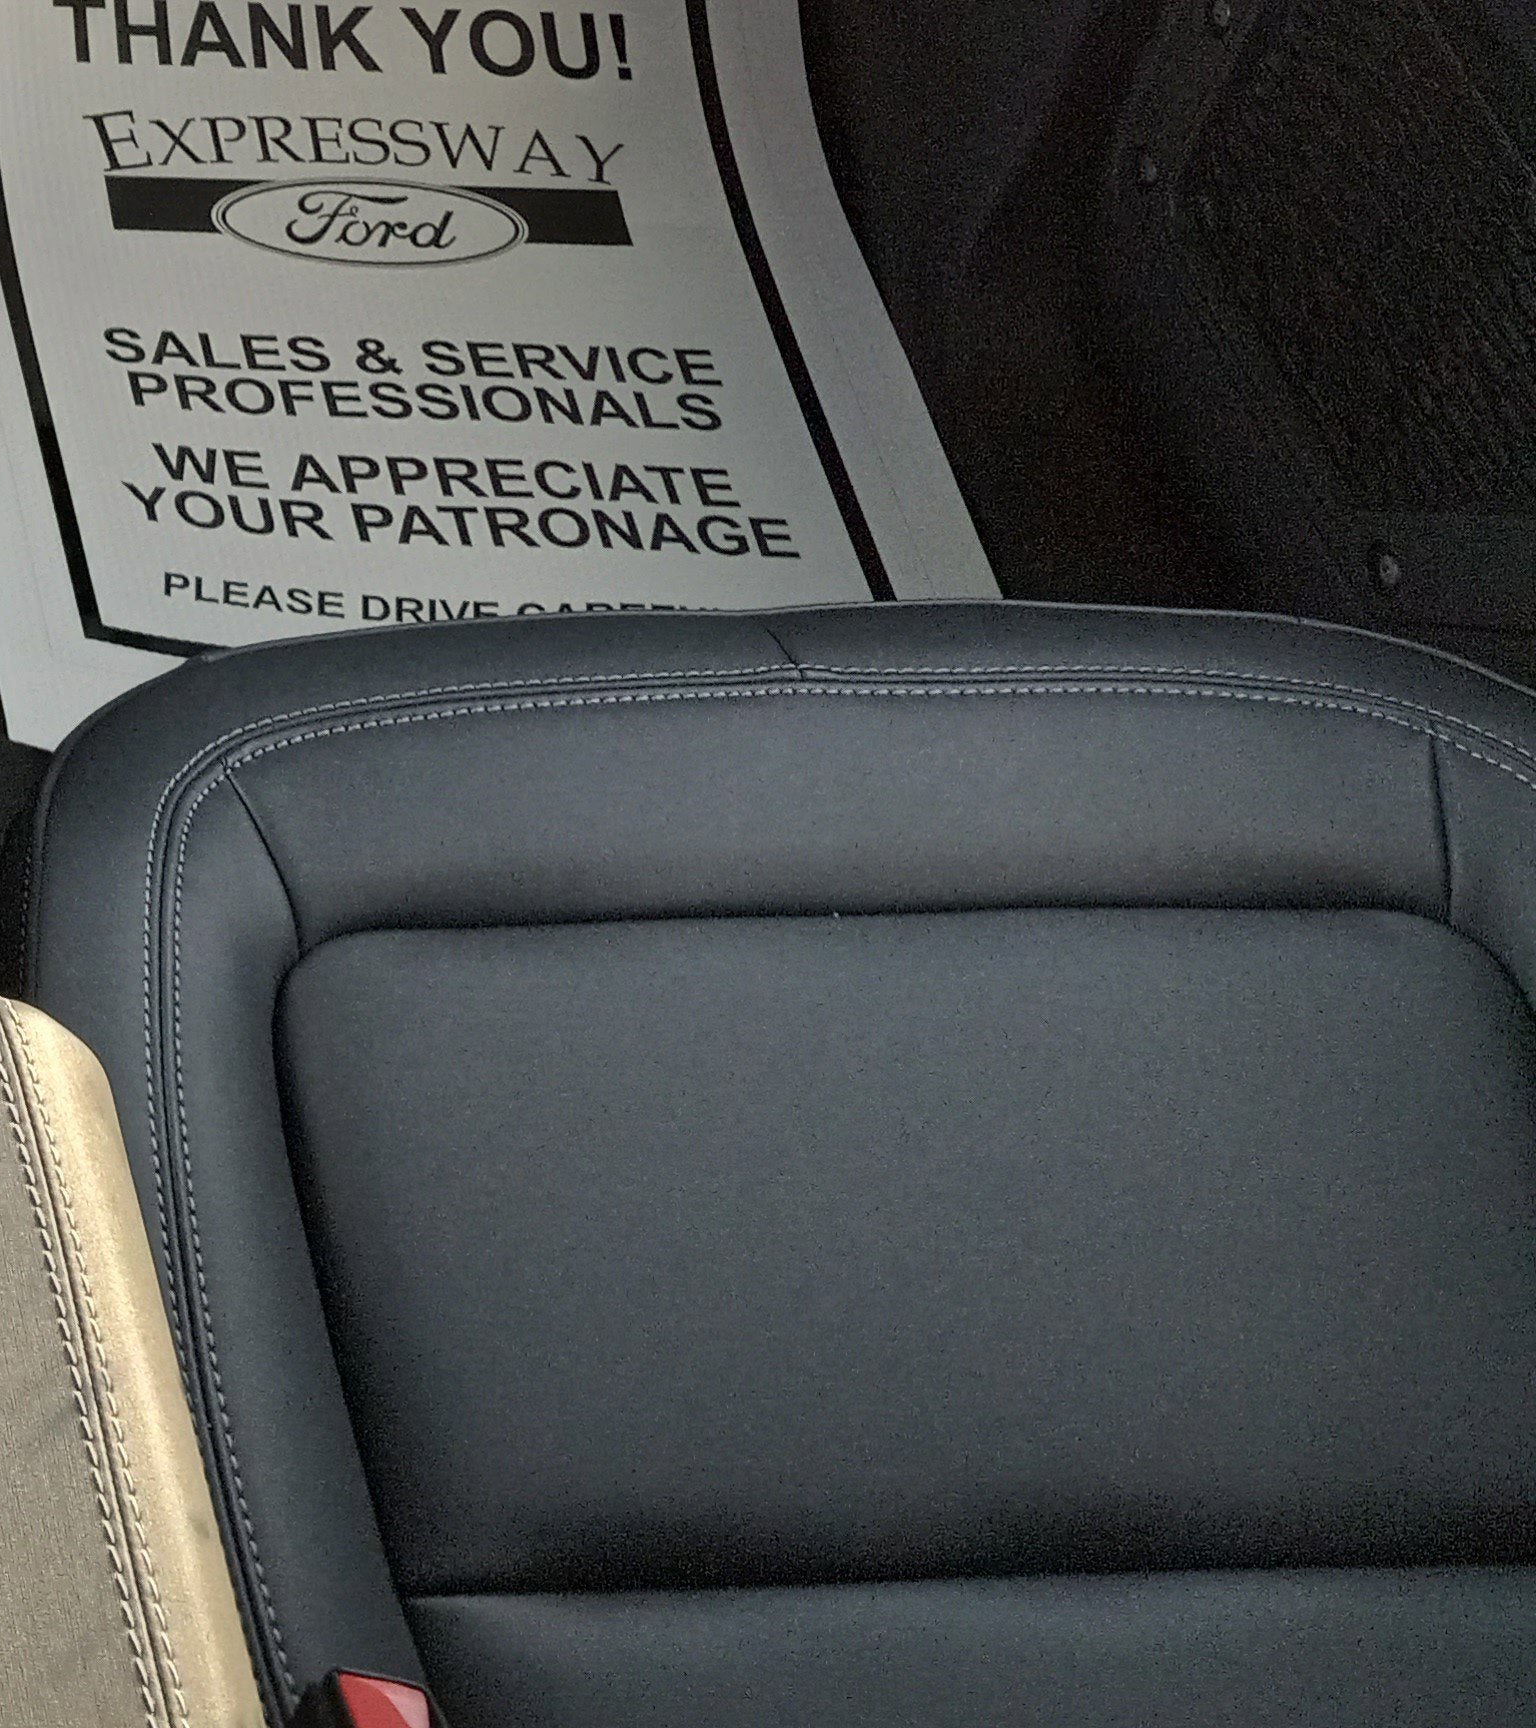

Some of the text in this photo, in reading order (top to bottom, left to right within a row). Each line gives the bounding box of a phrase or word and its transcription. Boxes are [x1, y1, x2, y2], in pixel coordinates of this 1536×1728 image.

[401, 6, 634, 80] YOU!
[82, 109, 624, 186] EXPRESSWAY
[284, 191, 455, 251] Ford
[103, 327, 724, 387] SALES & SERVICE
[129, 373, 723, 432] PROFESSIONALS
[151, 442, 741, 509] WE APPRECIATE
[122, 481, 801, 560] YOUR PATRONAGE
[161, 572, 500, 623] PLEASE DRIVE
